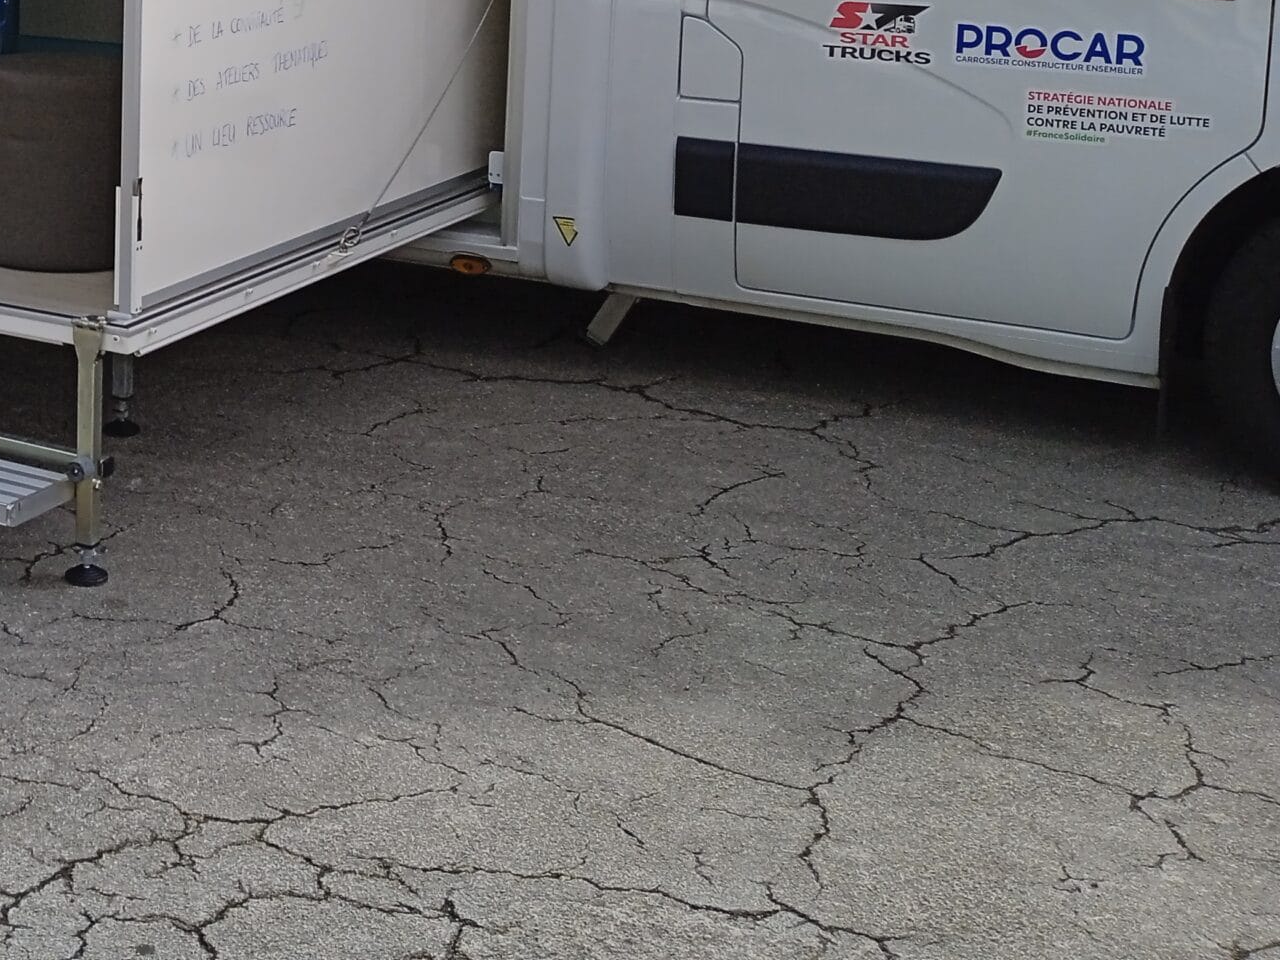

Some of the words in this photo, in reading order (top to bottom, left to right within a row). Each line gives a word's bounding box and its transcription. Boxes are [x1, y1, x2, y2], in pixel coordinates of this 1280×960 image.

[211, 21, 224, 40] LA
[840, 32, 910, 49] STAR
[822, 45, 931, 65] TRUCKS
[956, 24, 1145, 66] PROCAR
[955, 55, 1010, 66] CARROSSIER
[1011, 59, 1084, 71] CONSTRUCTEUR
[1086, 64, 1143, 75] ENSEMBLIER
[1027, 90, 1094, 106] STRATÉGIE
[1097, 96, 1173, 112] NATIONALE
[1027, 104, 1044, 115] DE
[1046, 104, 1128, 122] PRÉVENTION
[1131, 112, 1147, 123] ET
[1149, 114, 1166, 124] DE
[1169, 116, 1210, 128] LUTTE
[1026, 116, 1077, 130] CONTRE
[1080, 121, 1096, 132] LA
[1099, 123, 1166, 137] PAUVRETÉ
[1026, 130, 1106, 143] #FranceSolidaire
